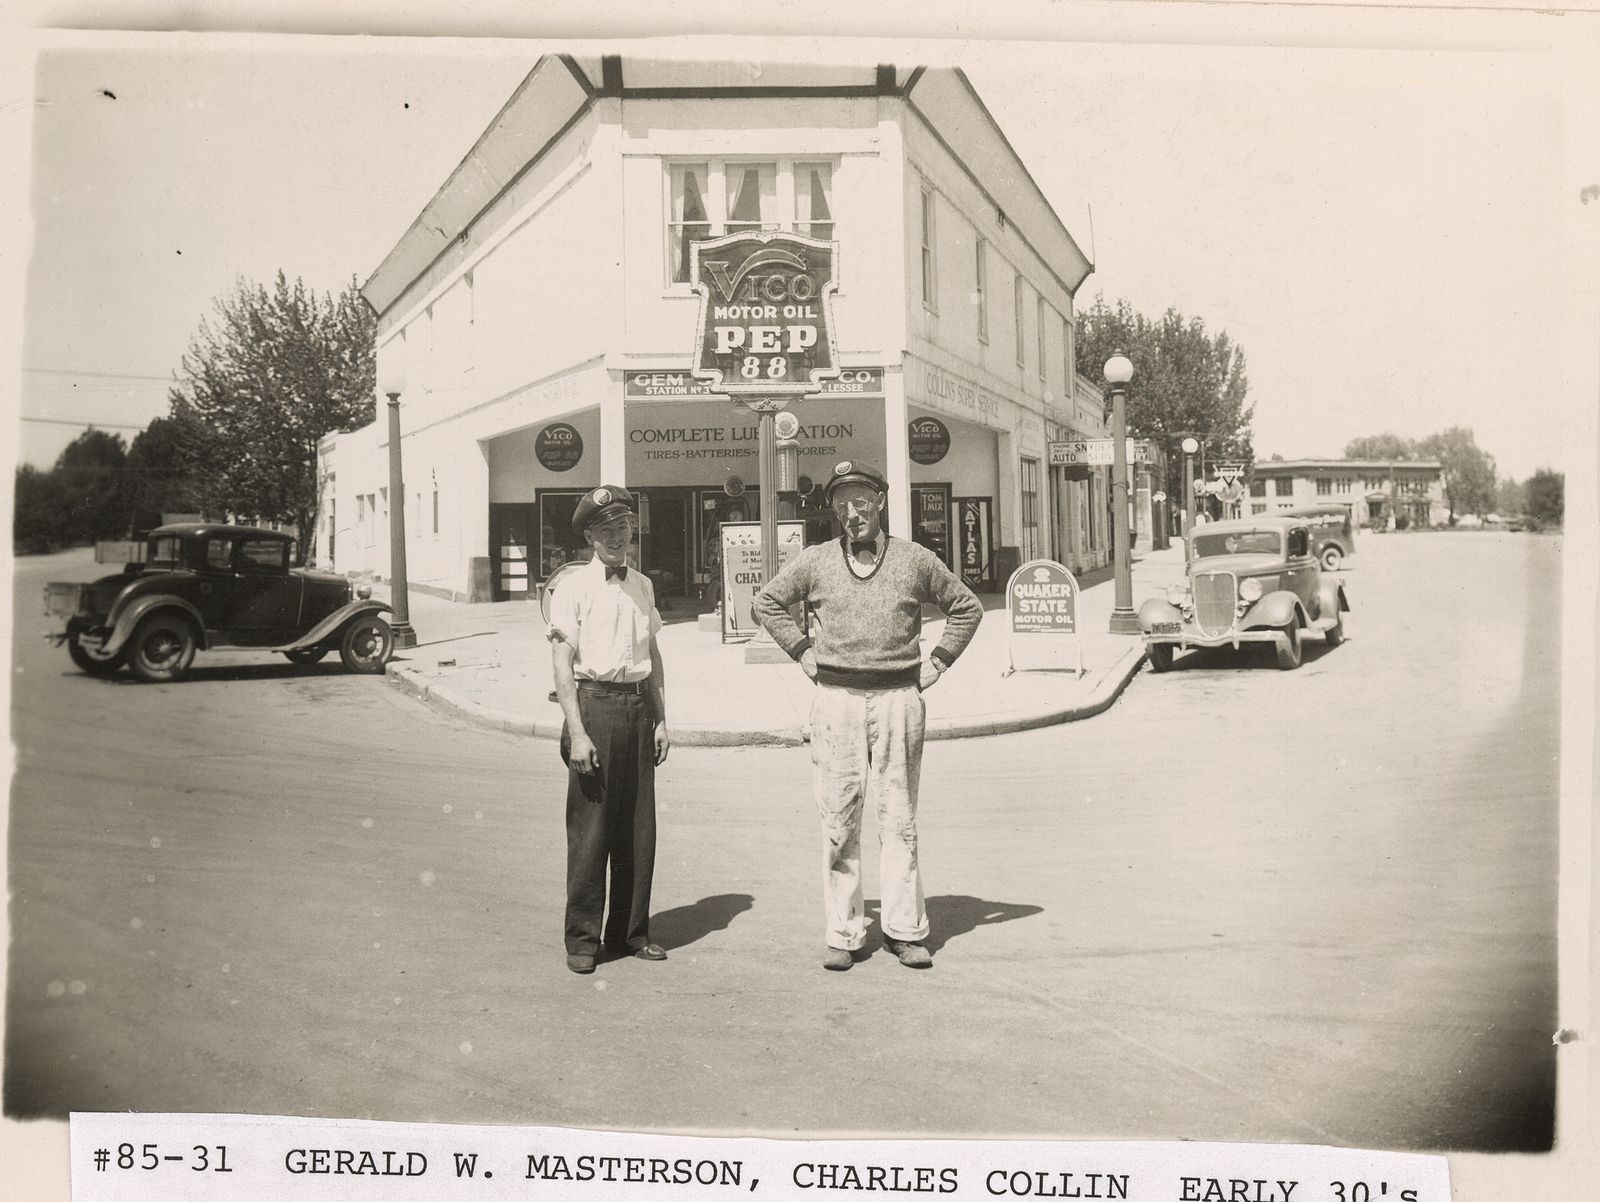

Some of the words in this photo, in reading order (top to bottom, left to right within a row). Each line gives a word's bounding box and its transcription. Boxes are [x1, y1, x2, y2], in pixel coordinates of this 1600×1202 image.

[714, 306, 777, 319] MOTOR
[783, 305, 817, 319] OIL
[714, 325, 817, 354] PEP
[741, 357, 787, 378] 88
[634, 373, 684, 386] GEM
[839, 371, 875, 383] CO.
[645, 386, 687, 395] STATION
[828, 383, 864, 392] LESSEE
[629, 428, 724, 443] COMPLETE
[732, 424, 853, 440] LUATION
[1052, 453, 1077, 462] AUTO
[965, 510, 977, 564] ATLAS
[1014, 583, 1071, 599] QUAKER
[1020, 600, 1067, 613] STATE
[1015, 615, 1052, 624] MOTOR
[1055, 615, 1074, 624] OIL
